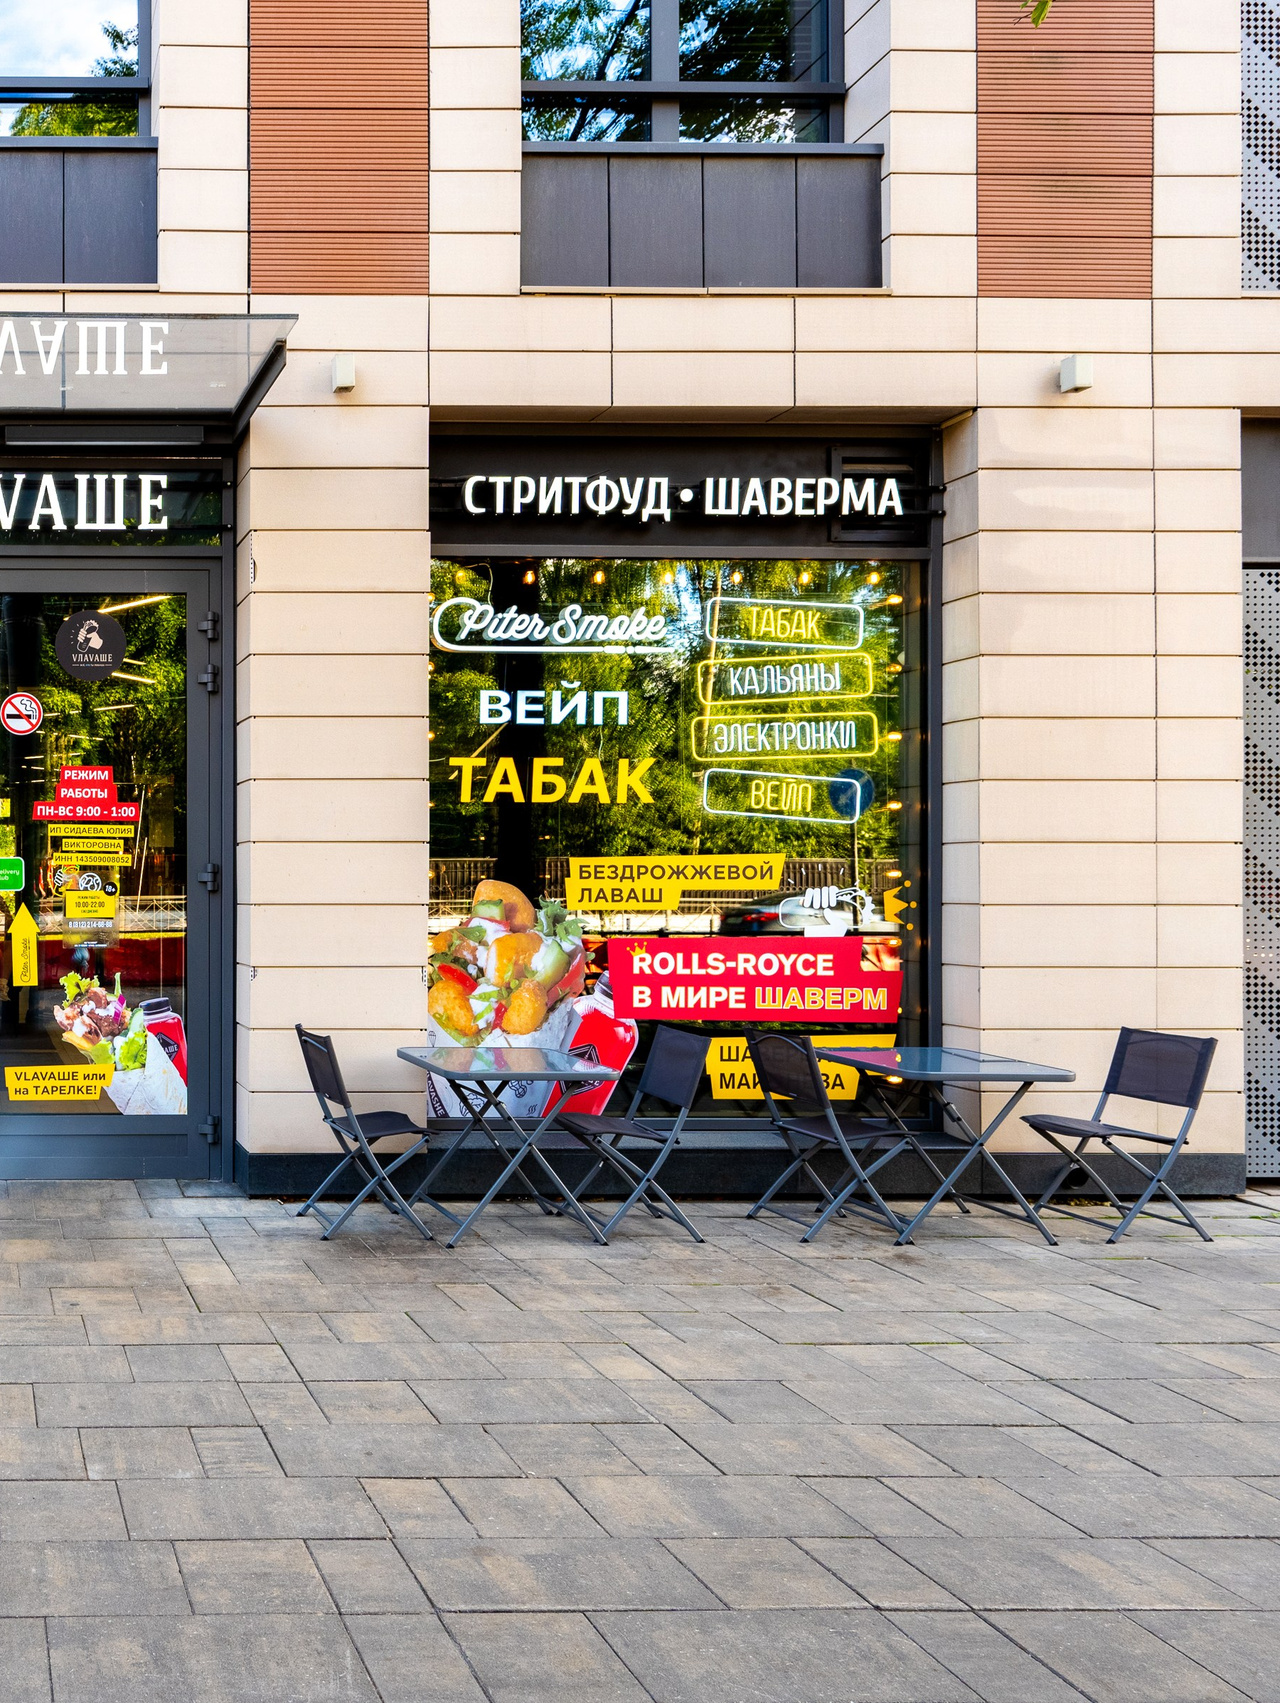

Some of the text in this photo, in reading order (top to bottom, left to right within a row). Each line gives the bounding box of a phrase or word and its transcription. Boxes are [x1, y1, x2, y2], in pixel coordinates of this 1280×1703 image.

[464, 475, 904, 522] СТРИТФУД ШАВЕРМА
[447, 598, 668, 644] Piter Smoke
[749, 606, 821, 639] ТАБАК
[729, 662, 841, 696] КАЛЬЯНЫ
[479, 680, 629, 726] ВЕЙП
[713, 720, 857, 753] ЭЛЕКТРОНКИ
[64, 770, 109, 780] РЕЖИМ
[448, 757, 657, 804] ТАБАК
[60, 788, 108, 798] РАБОТЫ
[751, 778, 813, 812] ВЕЙП
[37, 806, 73, 816] ПН-ВС
[76, 806, 101, 816] 9:00
[111, 807, 136, 817] 1:00
[63, 841, 122, 849] ВИКТОРОВНА
[578, 862, 774, 883] БЕЗДРОЖЖЕВОЙ
[577, 887, 664, 905] ЛАВАШ
[632, 951, 834, 977] ROLLS-ROYCE
[632, 986, 888, 1011] В МИРЕ ШАВЕРМ
[14, 1085, 97, 1095] на ТАРЕЛКЕ!
